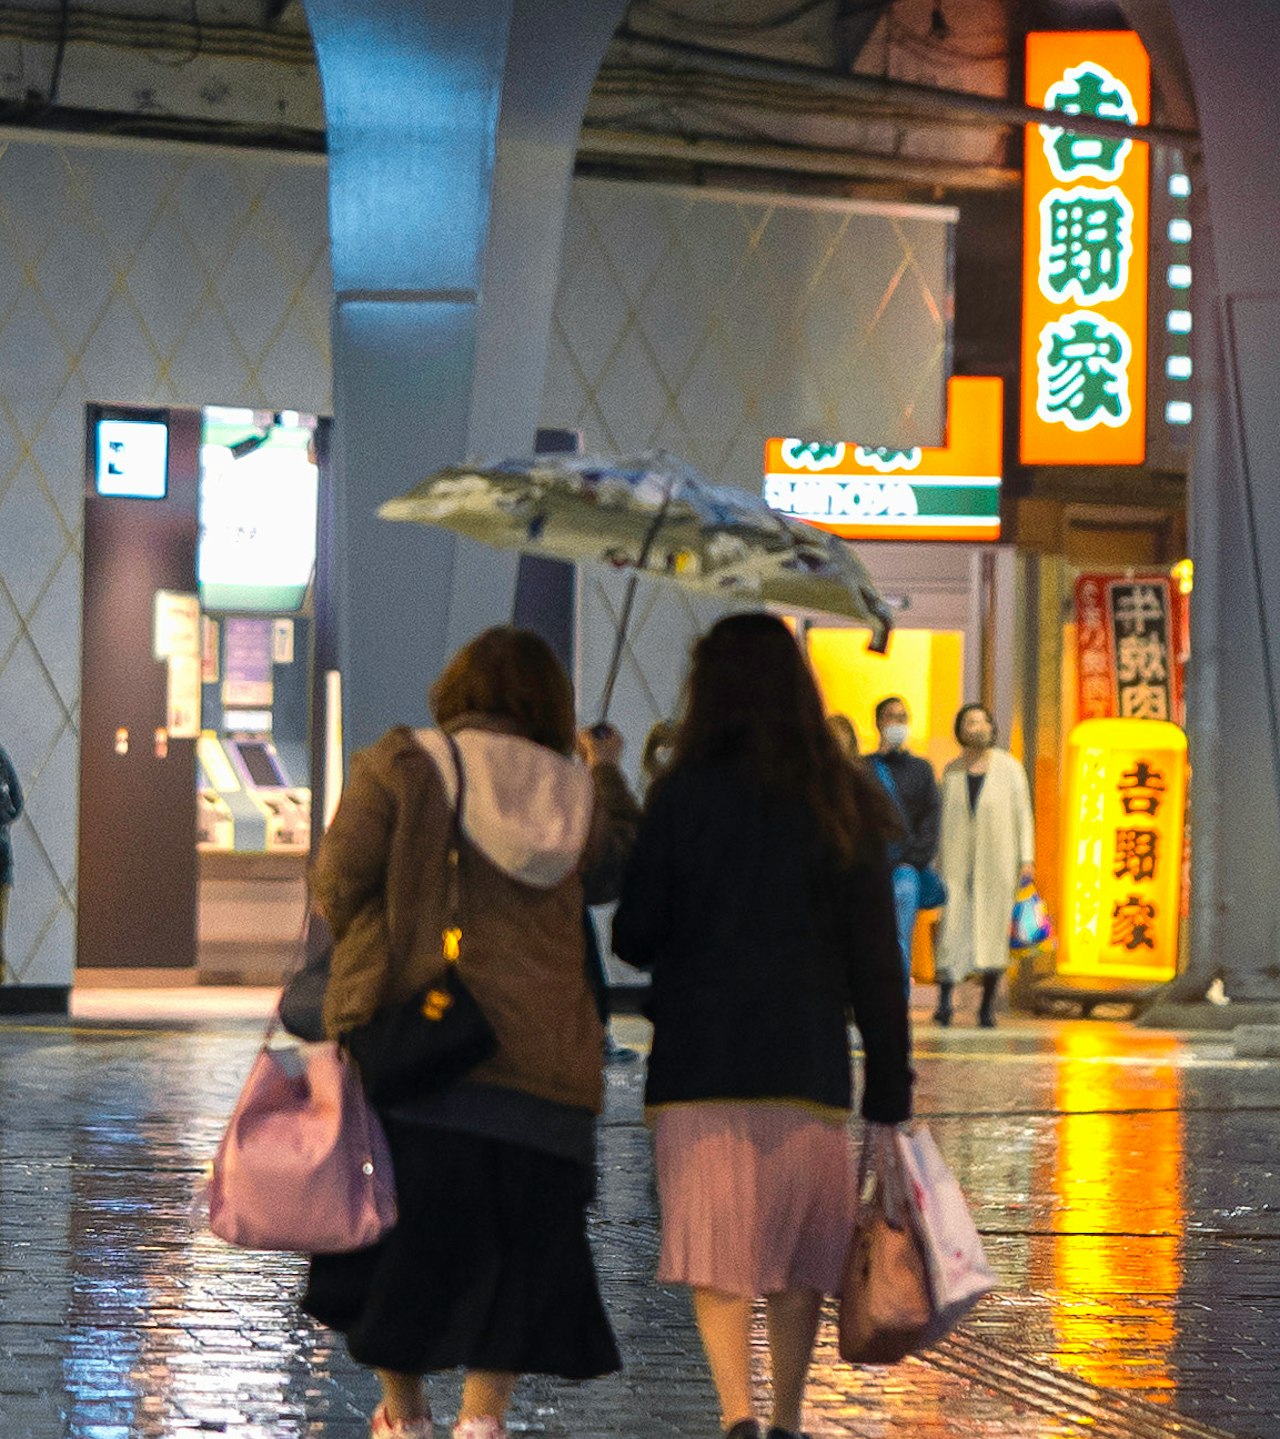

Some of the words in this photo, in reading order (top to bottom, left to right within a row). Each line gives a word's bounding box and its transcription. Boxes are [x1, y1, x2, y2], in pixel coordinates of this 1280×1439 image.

[1037, 61, 1137, 432] 吉野家
[1111, 761, 1166, 950] 吉野家
